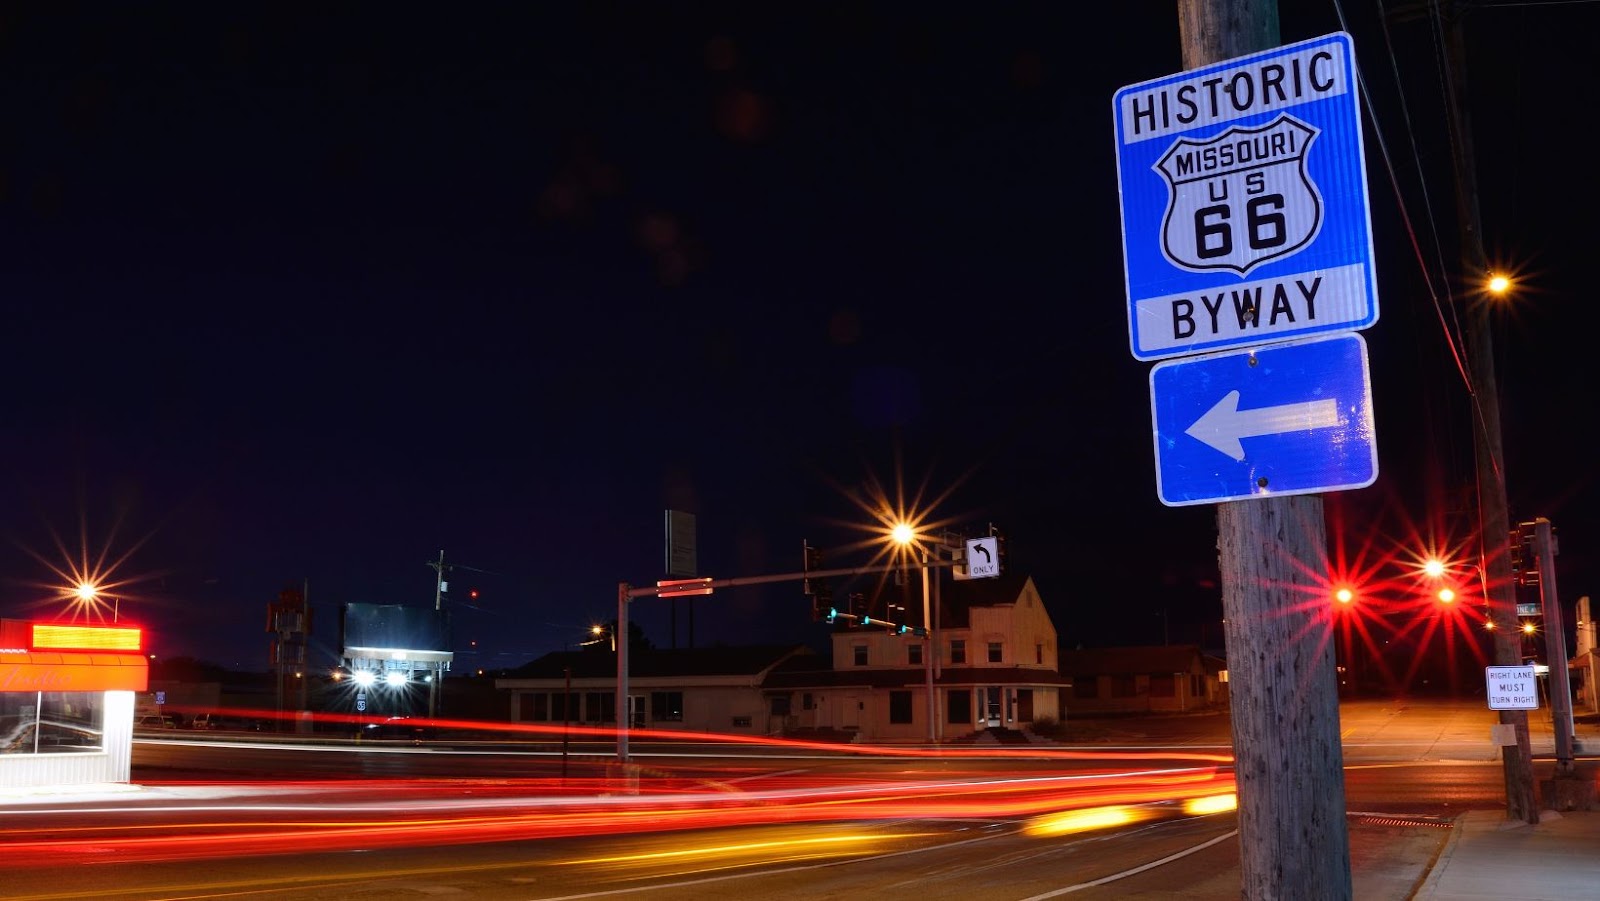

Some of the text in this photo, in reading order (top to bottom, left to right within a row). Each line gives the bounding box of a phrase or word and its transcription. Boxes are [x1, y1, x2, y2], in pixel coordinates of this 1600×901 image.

[1132, 51, 1335, 135] HISTORIC
[1176, 129, 1295, 177] MISSOURI
[1208, 171, 1265, 203] U S
[1194, 193, 1287, 260] 66
[1172, 276, 1323, 340] BYWAY
[973, 565, 994, 574] ONLY
[1499, 683, 1525, 692] MUST
[1513, 671, 1533, 679] LANE
[1491, 695, 1535, 704] TURN RIGHT
